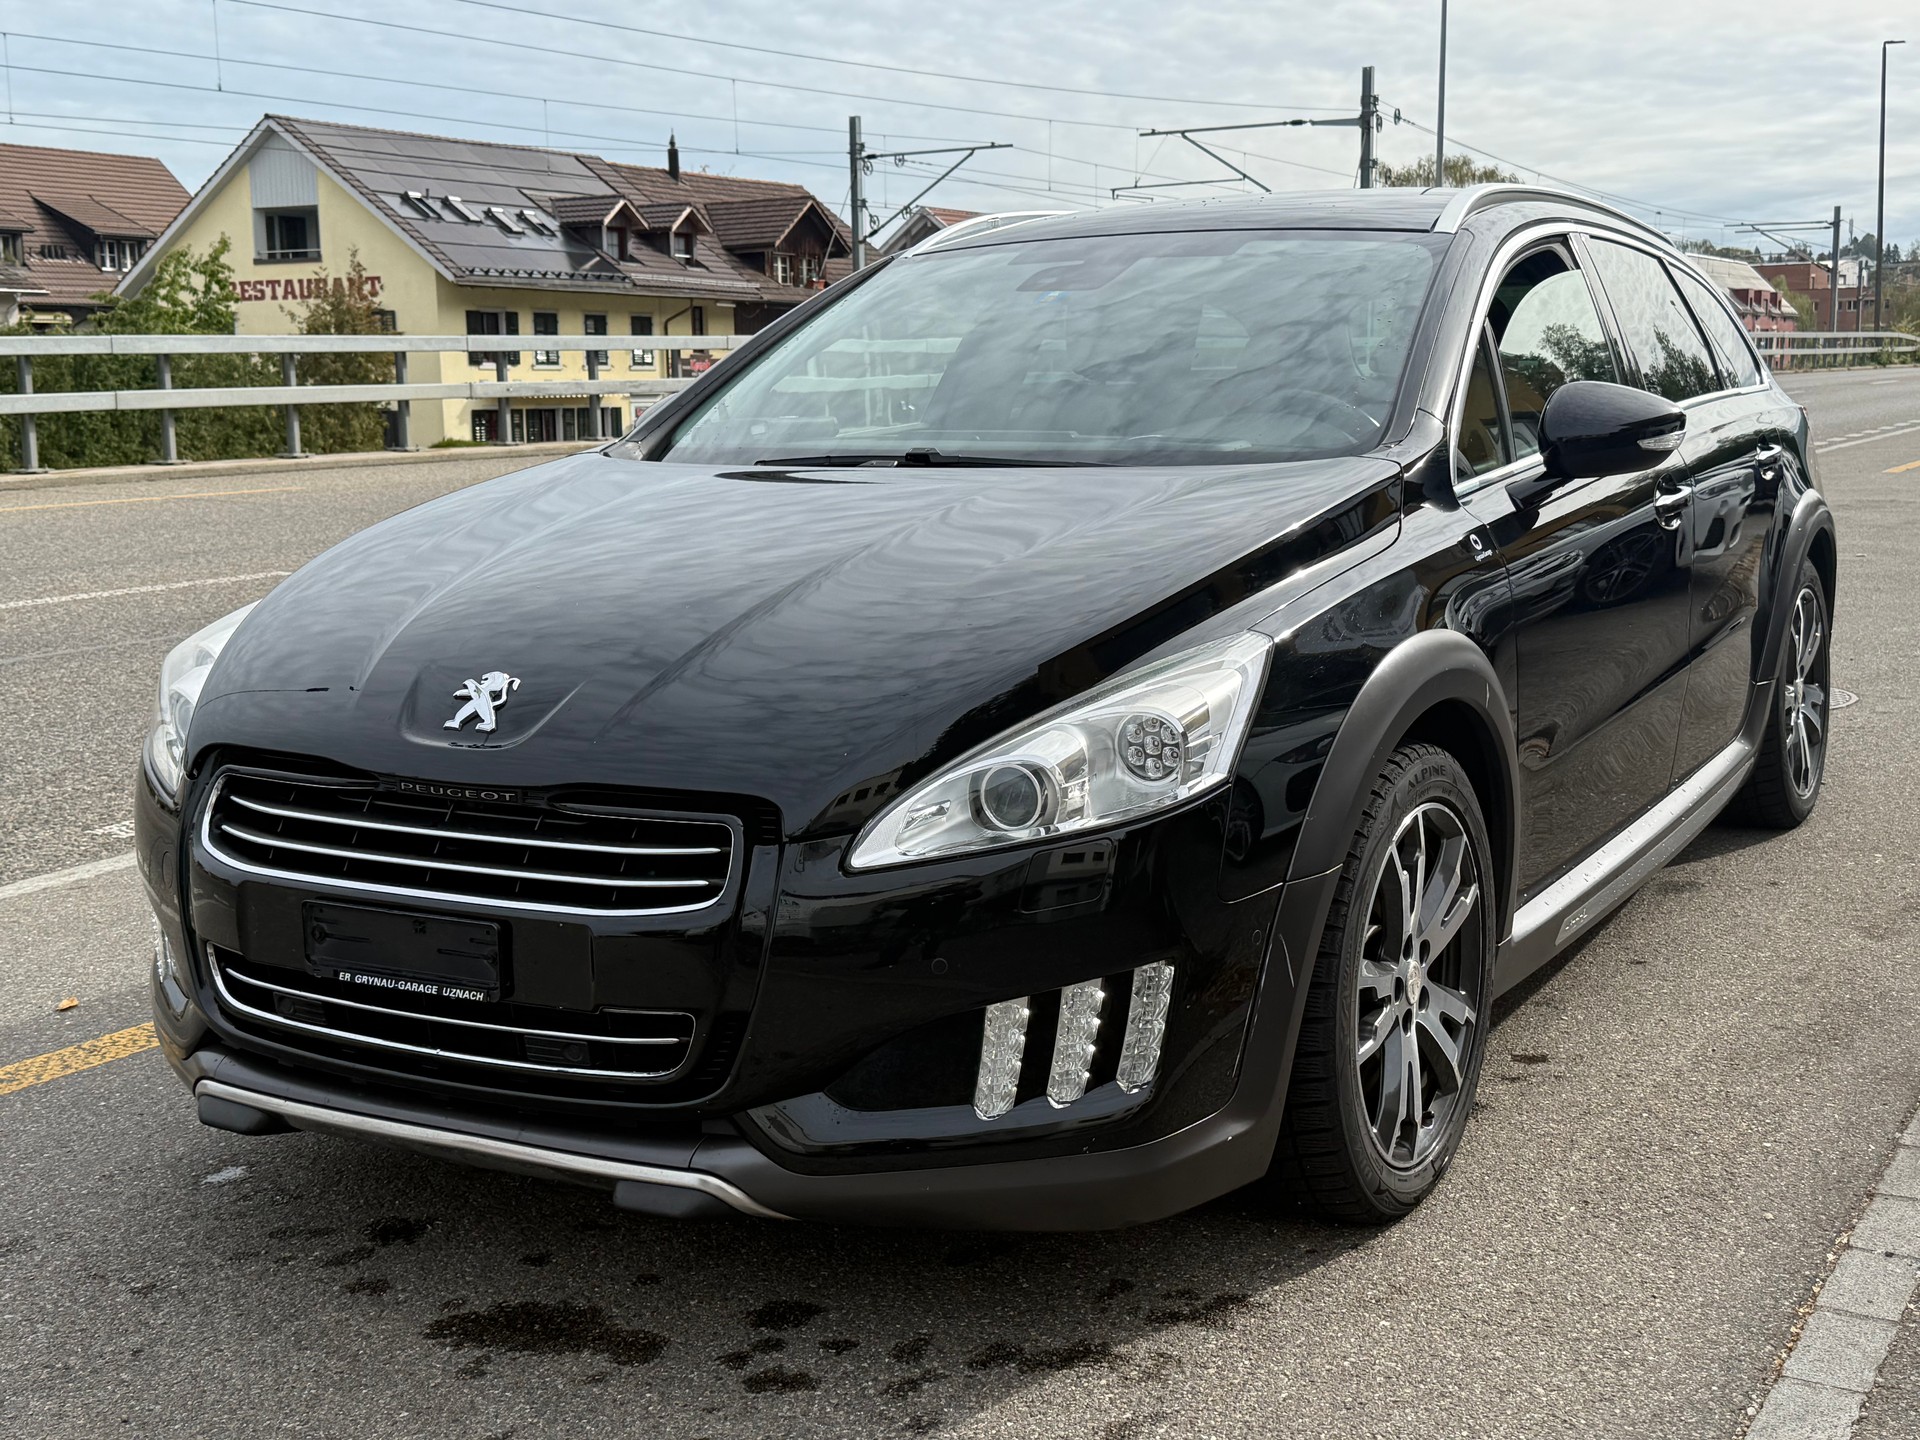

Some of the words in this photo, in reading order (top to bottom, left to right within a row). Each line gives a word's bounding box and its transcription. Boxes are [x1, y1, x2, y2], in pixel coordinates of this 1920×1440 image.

[400, 782, 515, 801] PEUGEOT
[1407, 764, 1446, 795] ALPINE
[338, 971, 351, 982] ER
[354, 974, 438, 995] GRYNAU-GARAGE
[442, 987, 484, 1002] UZNACH
